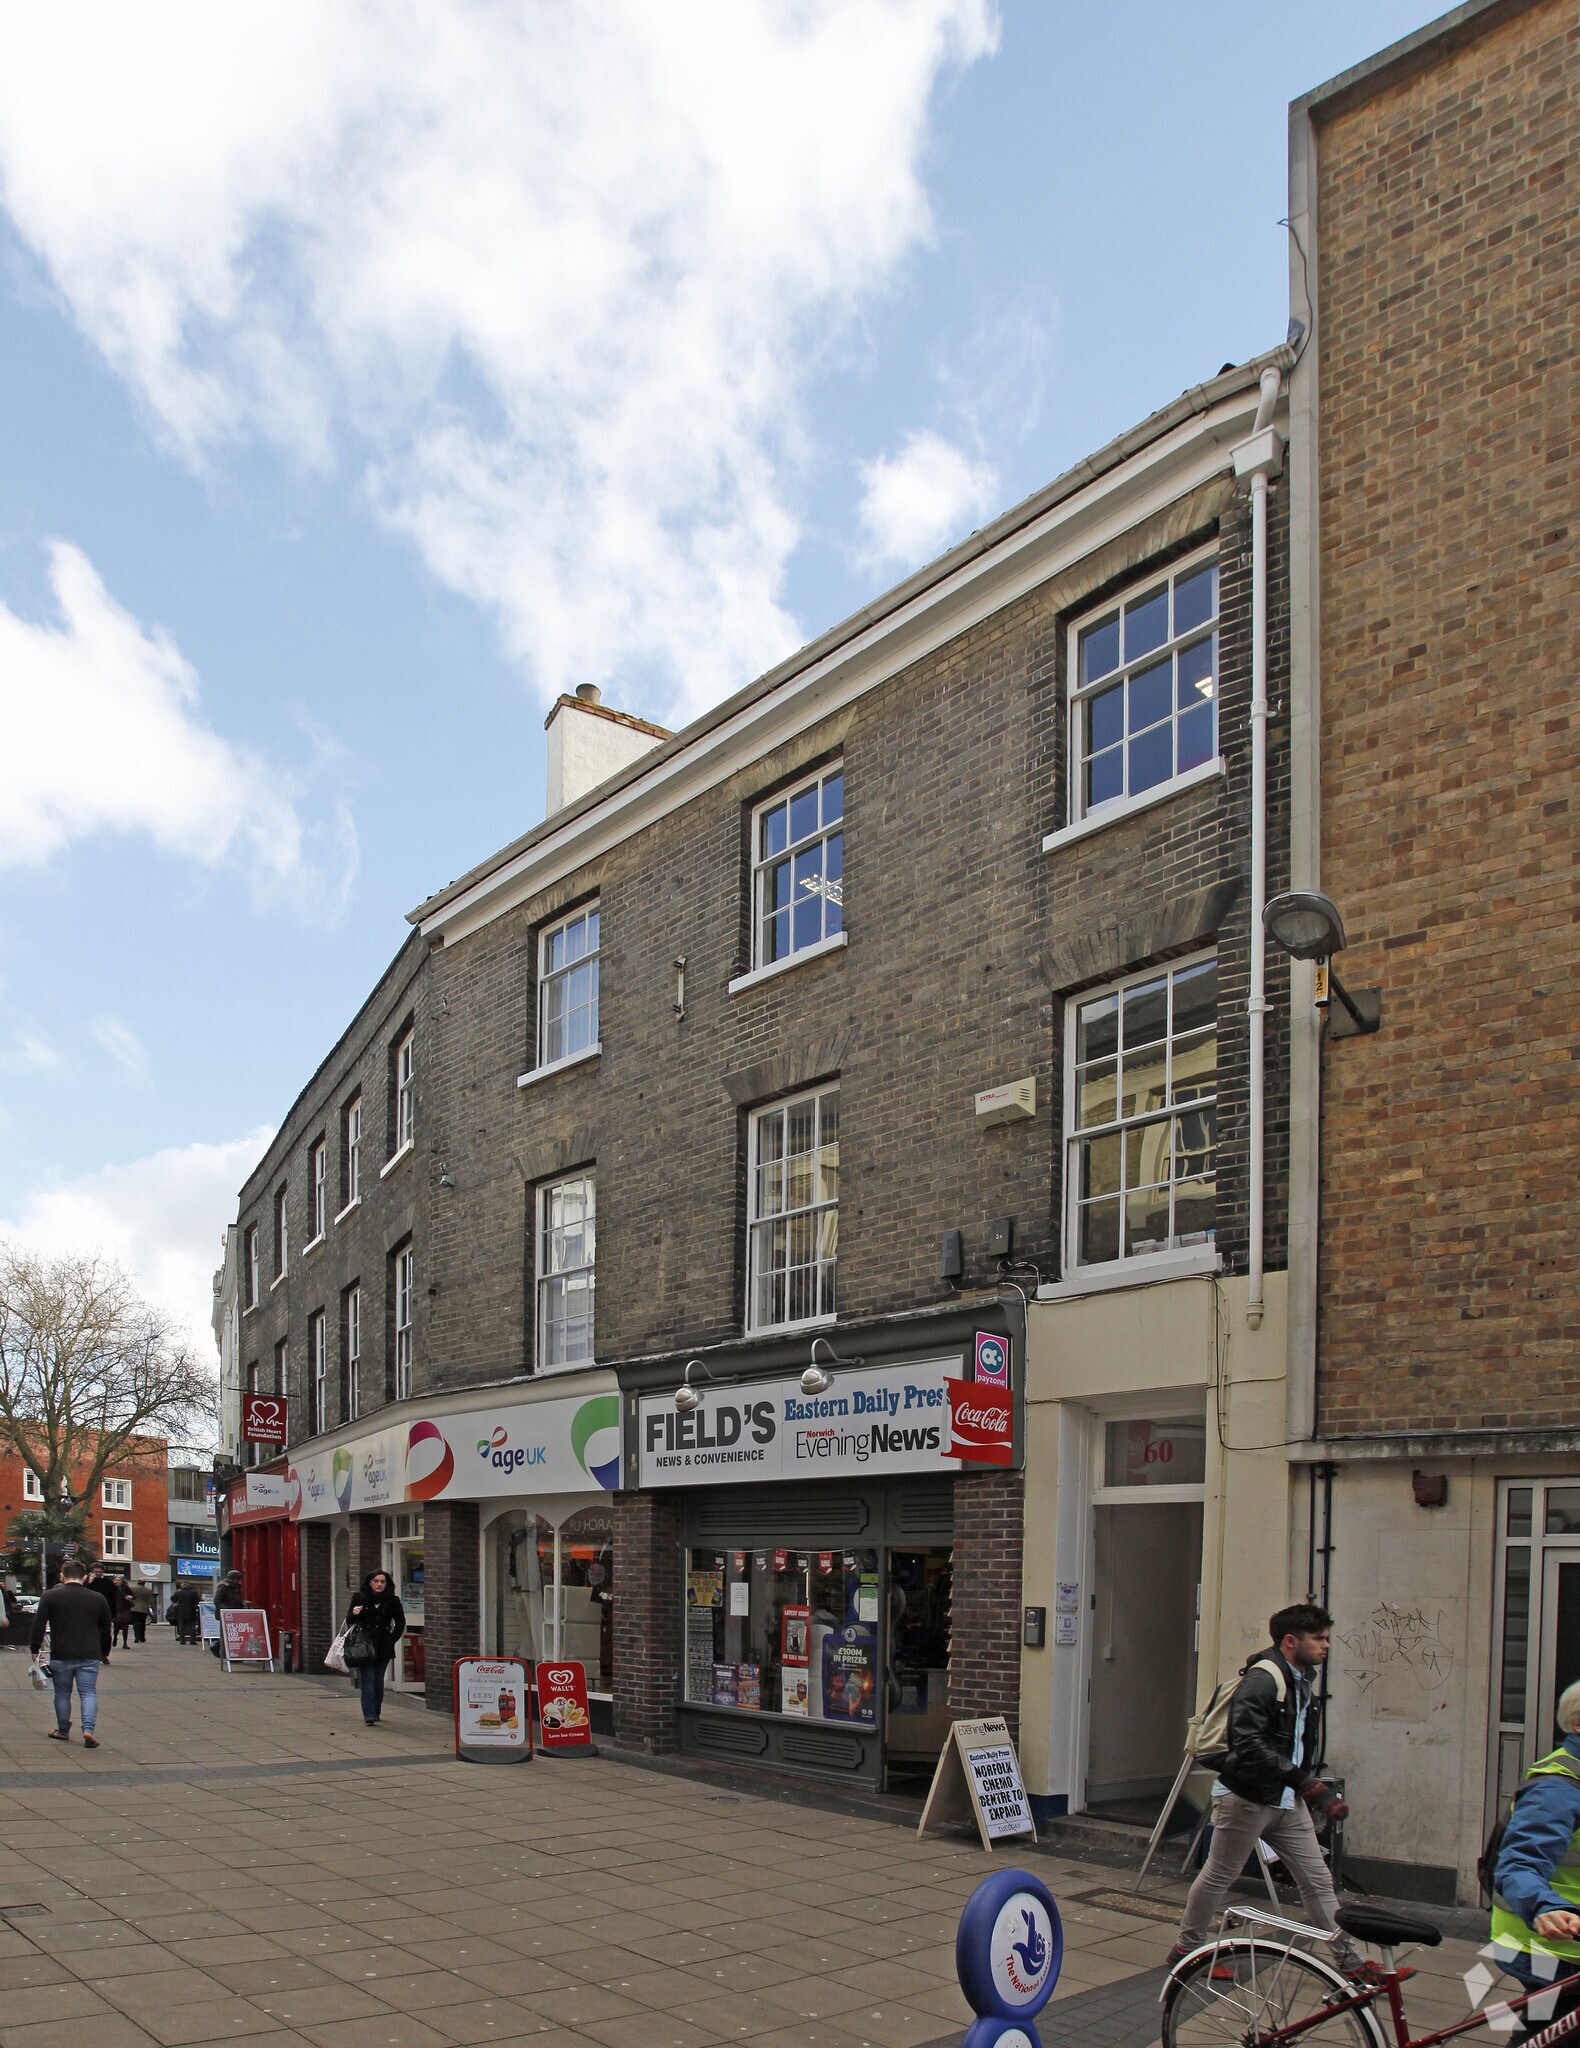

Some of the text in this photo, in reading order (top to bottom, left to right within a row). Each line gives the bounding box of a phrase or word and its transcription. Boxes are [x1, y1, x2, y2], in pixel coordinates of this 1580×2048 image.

[977, 1374, 1006, 1387] payzone
[784, 1398, 849, 1421] Eastern
[852, 1387, 900, 1417] Daily
[955, 1402, 1010, 1433] Coca-Cola
[247, 1426, 265, 1434] British
[646, 1401, 776, 1453] FIELD'S
[806, 1428, 834, 1438] Norwich
[247, 1431, 282, 1440] Foundation
[656, 1449, 765, 1468] NEWS & CONVENIENCE
[1144, 1440, 1173, 1464] 60
[833, 1654, 868, 1665] IN PRIZES
[838, 1647, 863, 1657] £100M
[969, 1753, 987, 1762] Eastern
[987, 1752, 999, 1760] Daily
[974, 1761, 1013, 1778] NORFOLK
[982, 1776, 1013, 1792] CHEMO
[979, 1789, 1024, 1808] CENTRE TO
[988, 1804, 1022, 1821] EXPAND
[997, 1822, 1021, 1833] TUESDAY
[1006, 1954, 1015, 1976] The
[1011, 1975, 1040, 1993] National
